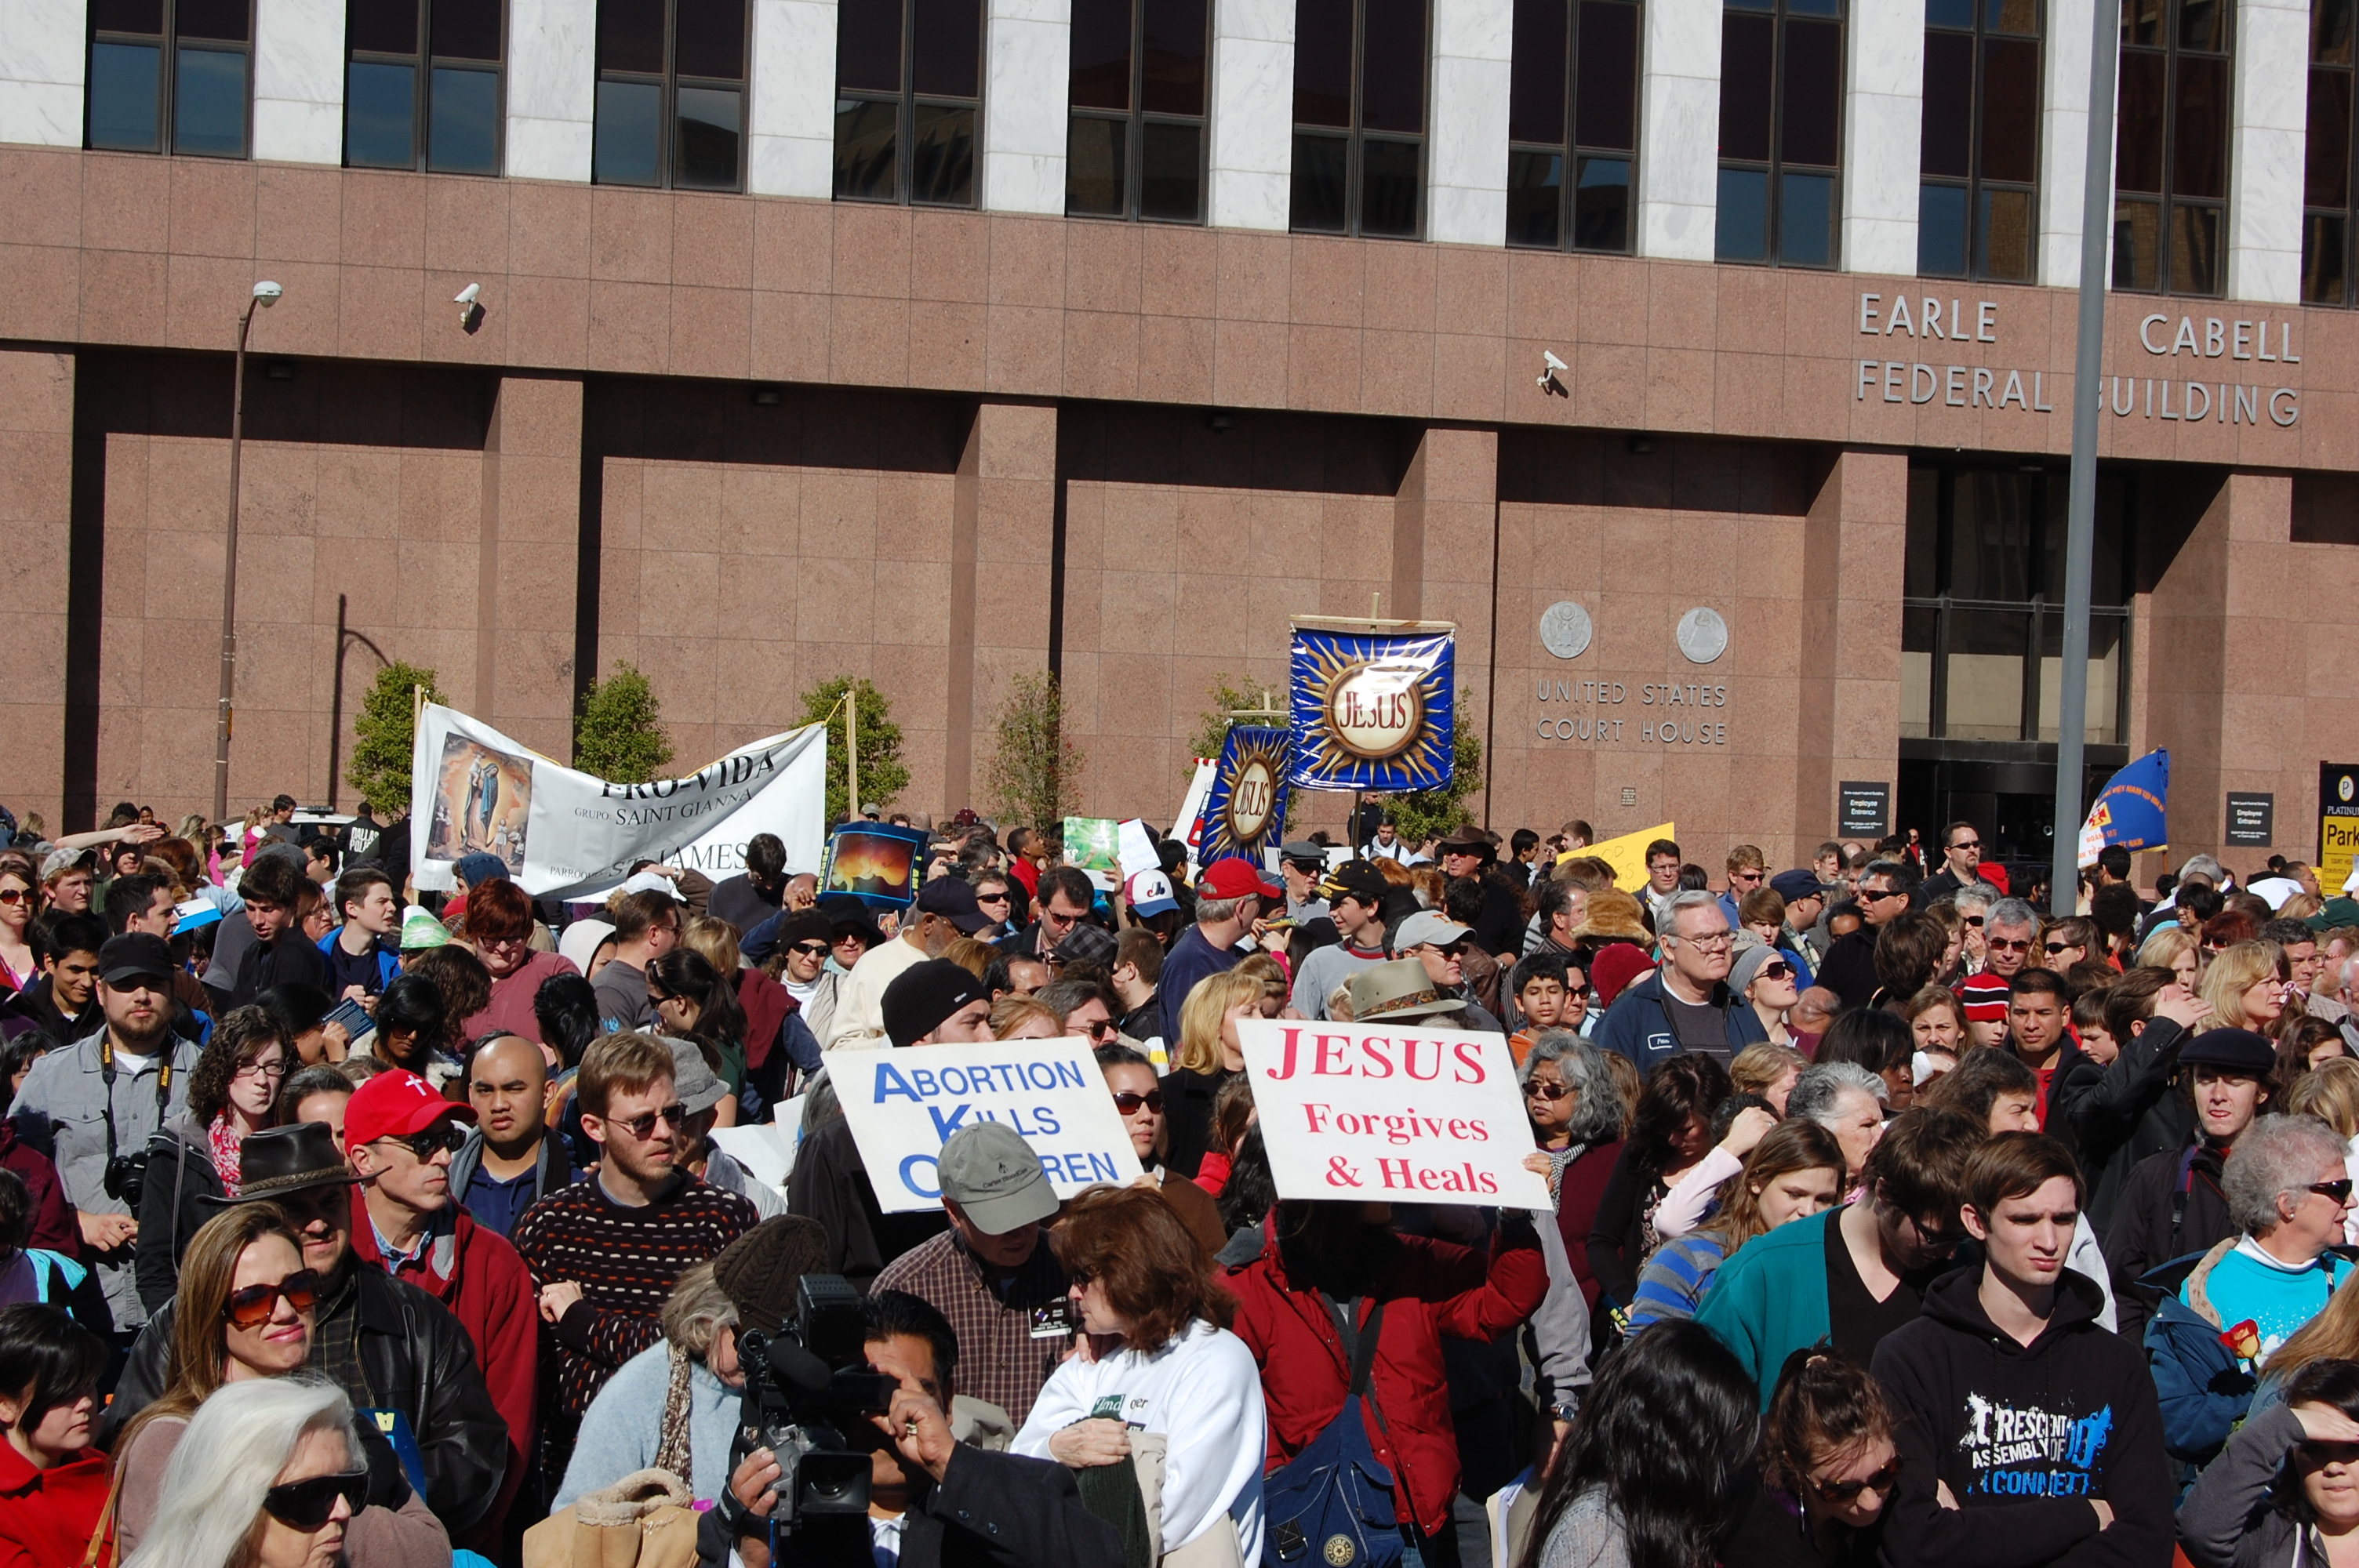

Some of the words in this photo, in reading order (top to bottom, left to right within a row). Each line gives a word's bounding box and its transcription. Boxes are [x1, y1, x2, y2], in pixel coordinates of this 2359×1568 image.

[1860, 292, 1997, 343] EARLE
[2139, 314, 2301, 363] CABELL
[1856, 359, 2053, 413] FEDERAL
[2097, 377, 2299, 426] UILDING
[1339, 691, 1408, 730] JESUS
[1537, 680, 1626, 704] UNITED
[1642, 683, 1726, 707] STATES
[1537, 718, 1623, 742] COURT
[1641, 720, 1725, 744] HOUSE
[575, 807, 612, 821] GRUPO:
[616, 806, 677, 826] SAINT
[681, 787, 753, 818] GIANNA
[2327, 805, 2359, 815] PLATINU
[1267, 1028, 1486, 1084] JESUS
[874, 1061, 1086, 1104] ABORTION
[1300, 1103, 1488, 1145] Forgives
[899, 1152, 1120, 1199] CREN
[1325, 1156, 1364, 1188] &
[1375, 1157, 1499, 1194] Heals
[1972, 1438, 2049, 1469] ASSEMBLY
[2050, 1438, 2066, 1462] OF
